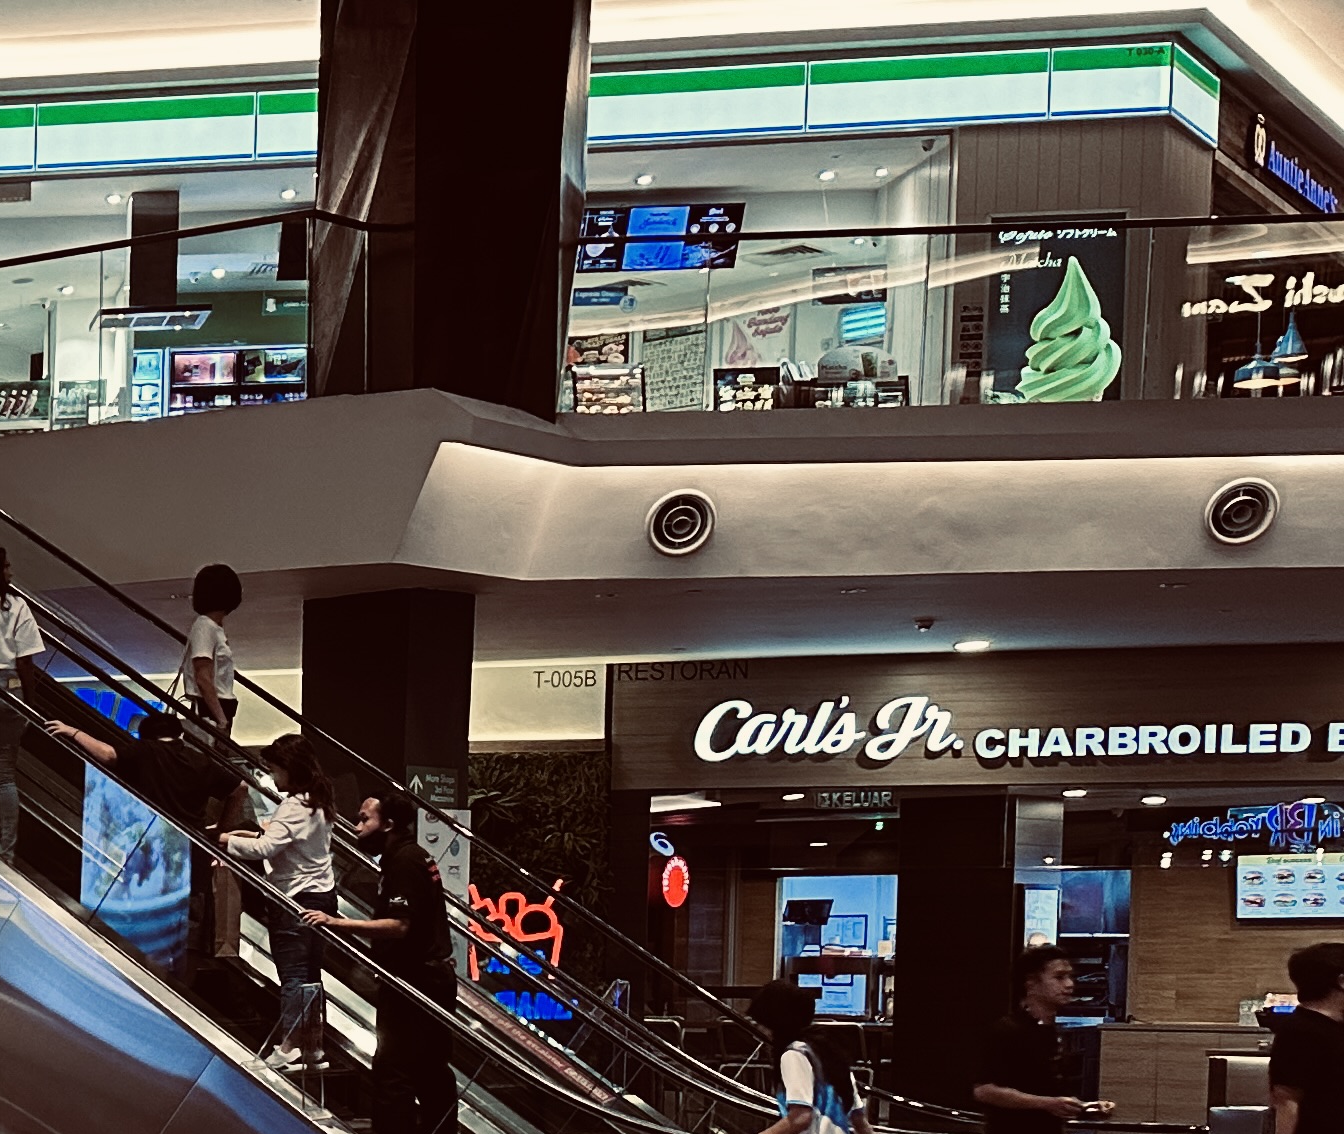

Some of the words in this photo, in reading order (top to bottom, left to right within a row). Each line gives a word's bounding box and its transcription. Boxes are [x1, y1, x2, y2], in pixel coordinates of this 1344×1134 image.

[533, 669, 597, 689] T-005B
[617, 661, 749, 682] RESTORAN
[693, 695, 865, 763] Carl's
[865, 695, 964, 762] Jr.
[974, 723, 1311, 759] CHARBROILED
[831, 791, 893, 808] KELUAR
